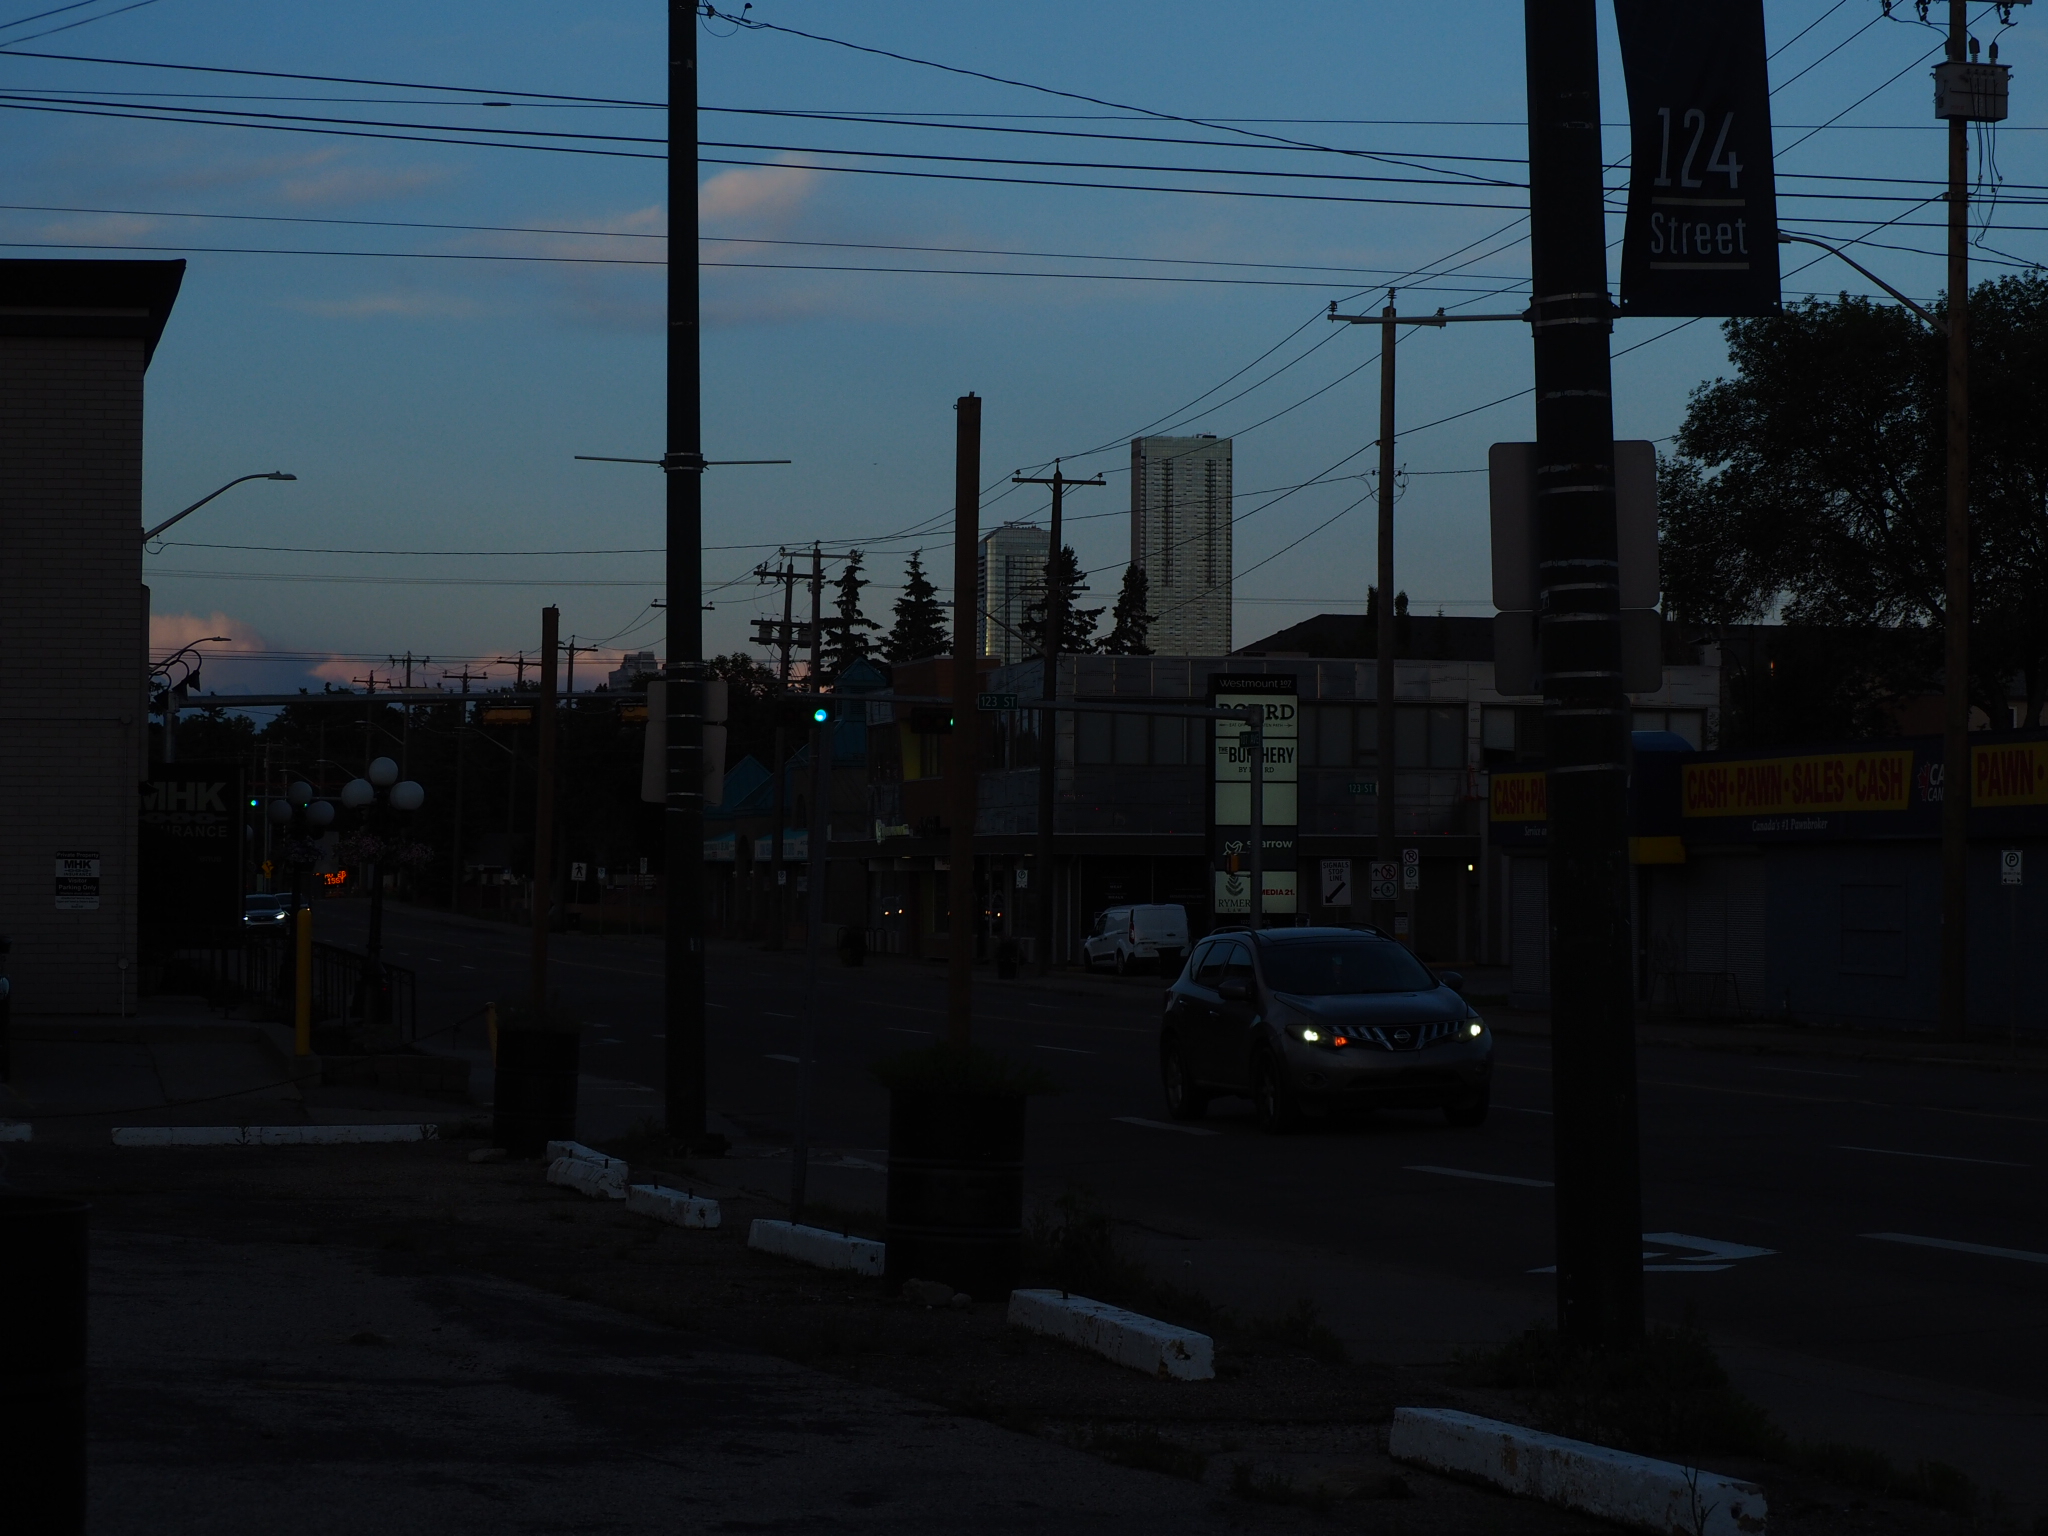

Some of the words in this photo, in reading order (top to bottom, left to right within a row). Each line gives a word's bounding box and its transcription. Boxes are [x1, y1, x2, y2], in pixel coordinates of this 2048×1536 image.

[1653, 107, 1744, 189] 124
[1650, 211, 1748, 255] Street
[1219, 679, 1278, 689] Westmount
[1280, 679, 1292, 688] 107
[981, 696, 998, 707] 123
[1003, 696, 1016, 707] ST
[1930, 763, 1944, 786] CA
[1977, 749, 2034, 798] PAWN
[1349, 784, 1361, 793] 123
[1364, 784, 1373, 793] ST
[1687, 768, 1728, 810] CASH
[1737, 764, 1782, 807] PAWN
[1792, 759, 1844, 804] SALES
[1855, 757, 1903, 802] CASH
[1494, 778, 1525, 815] CASH
[1530, 778, 1546, 814] PA
[1927, 787, 1944, 802] CAN
[1752, 819, 1780, 831] Canada's
[1790, 817, 1828, 830] Pawnbroker
[1247, 840, 1293, 849] sarrow
[64, 860, 91, 869] MHK
[82, 884, 97, 892] Only
[1218, 899, 1251, 908] RYMER
